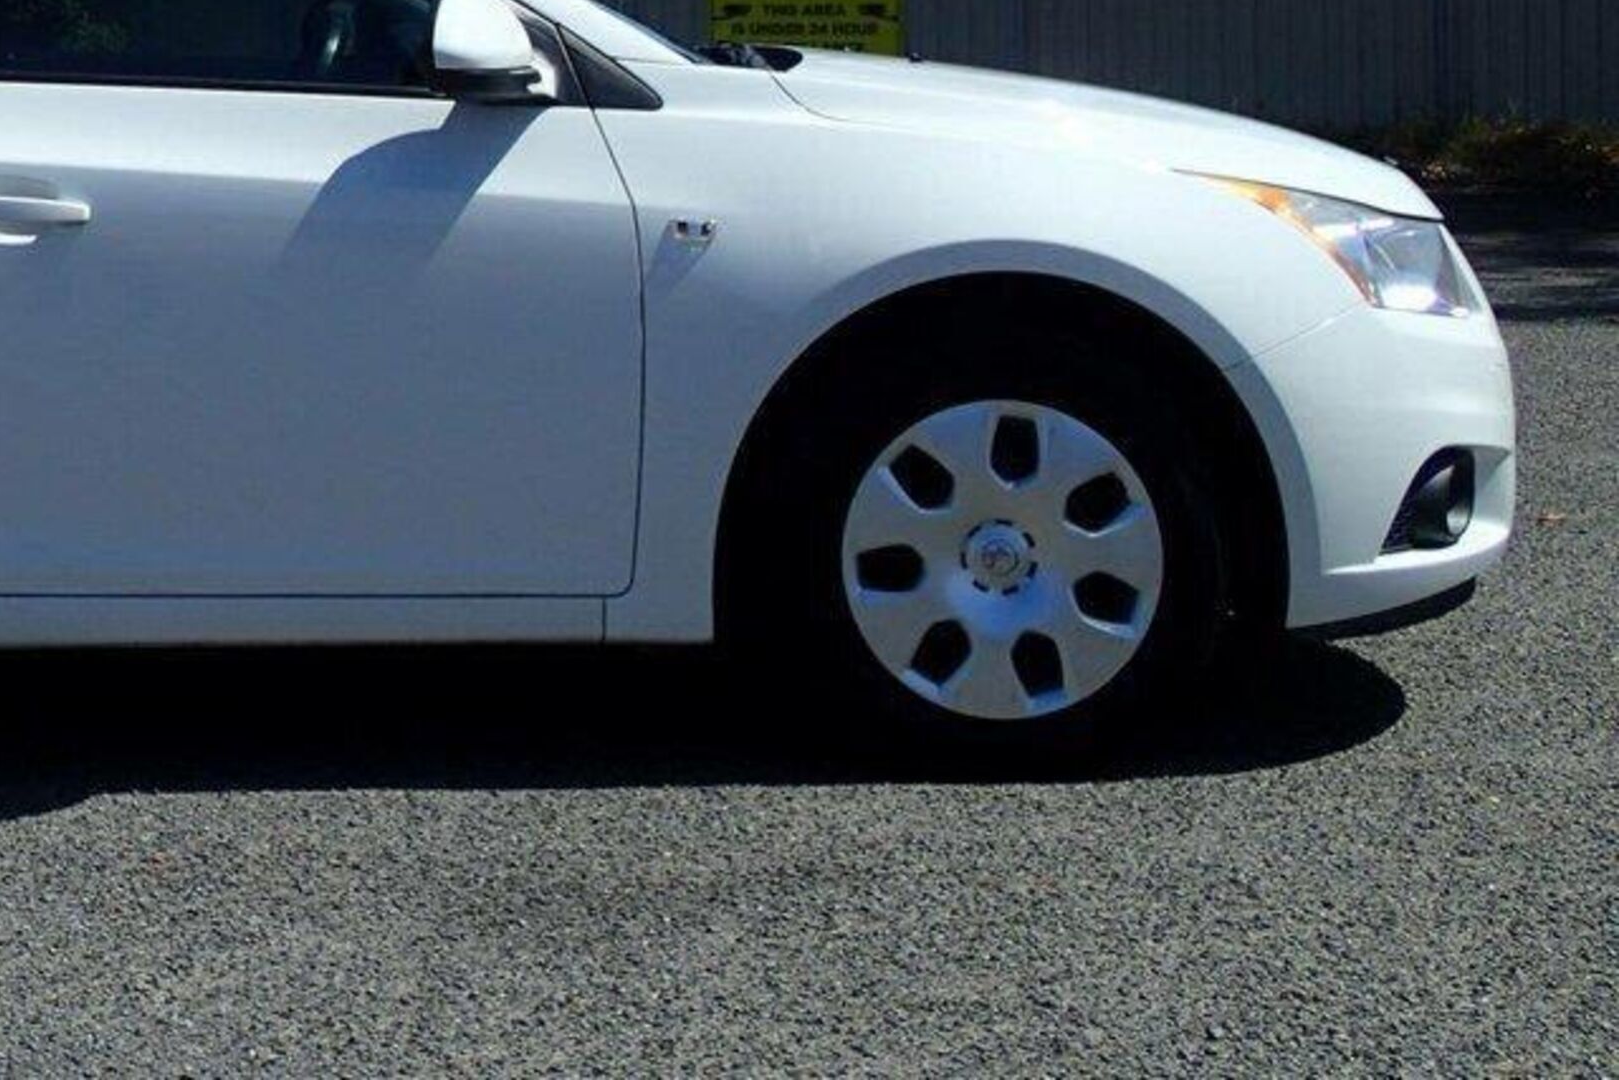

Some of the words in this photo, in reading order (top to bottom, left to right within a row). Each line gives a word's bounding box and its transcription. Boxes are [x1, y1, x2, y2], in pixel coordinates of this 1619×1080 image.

[764, 4, 797, 16] THIS
[802, 4, 846, 16] AREA
[749, 23, 805, 36] UNDER
[808, 23, 829, 36] 24
[832, 23, 879, 36] HOUR
